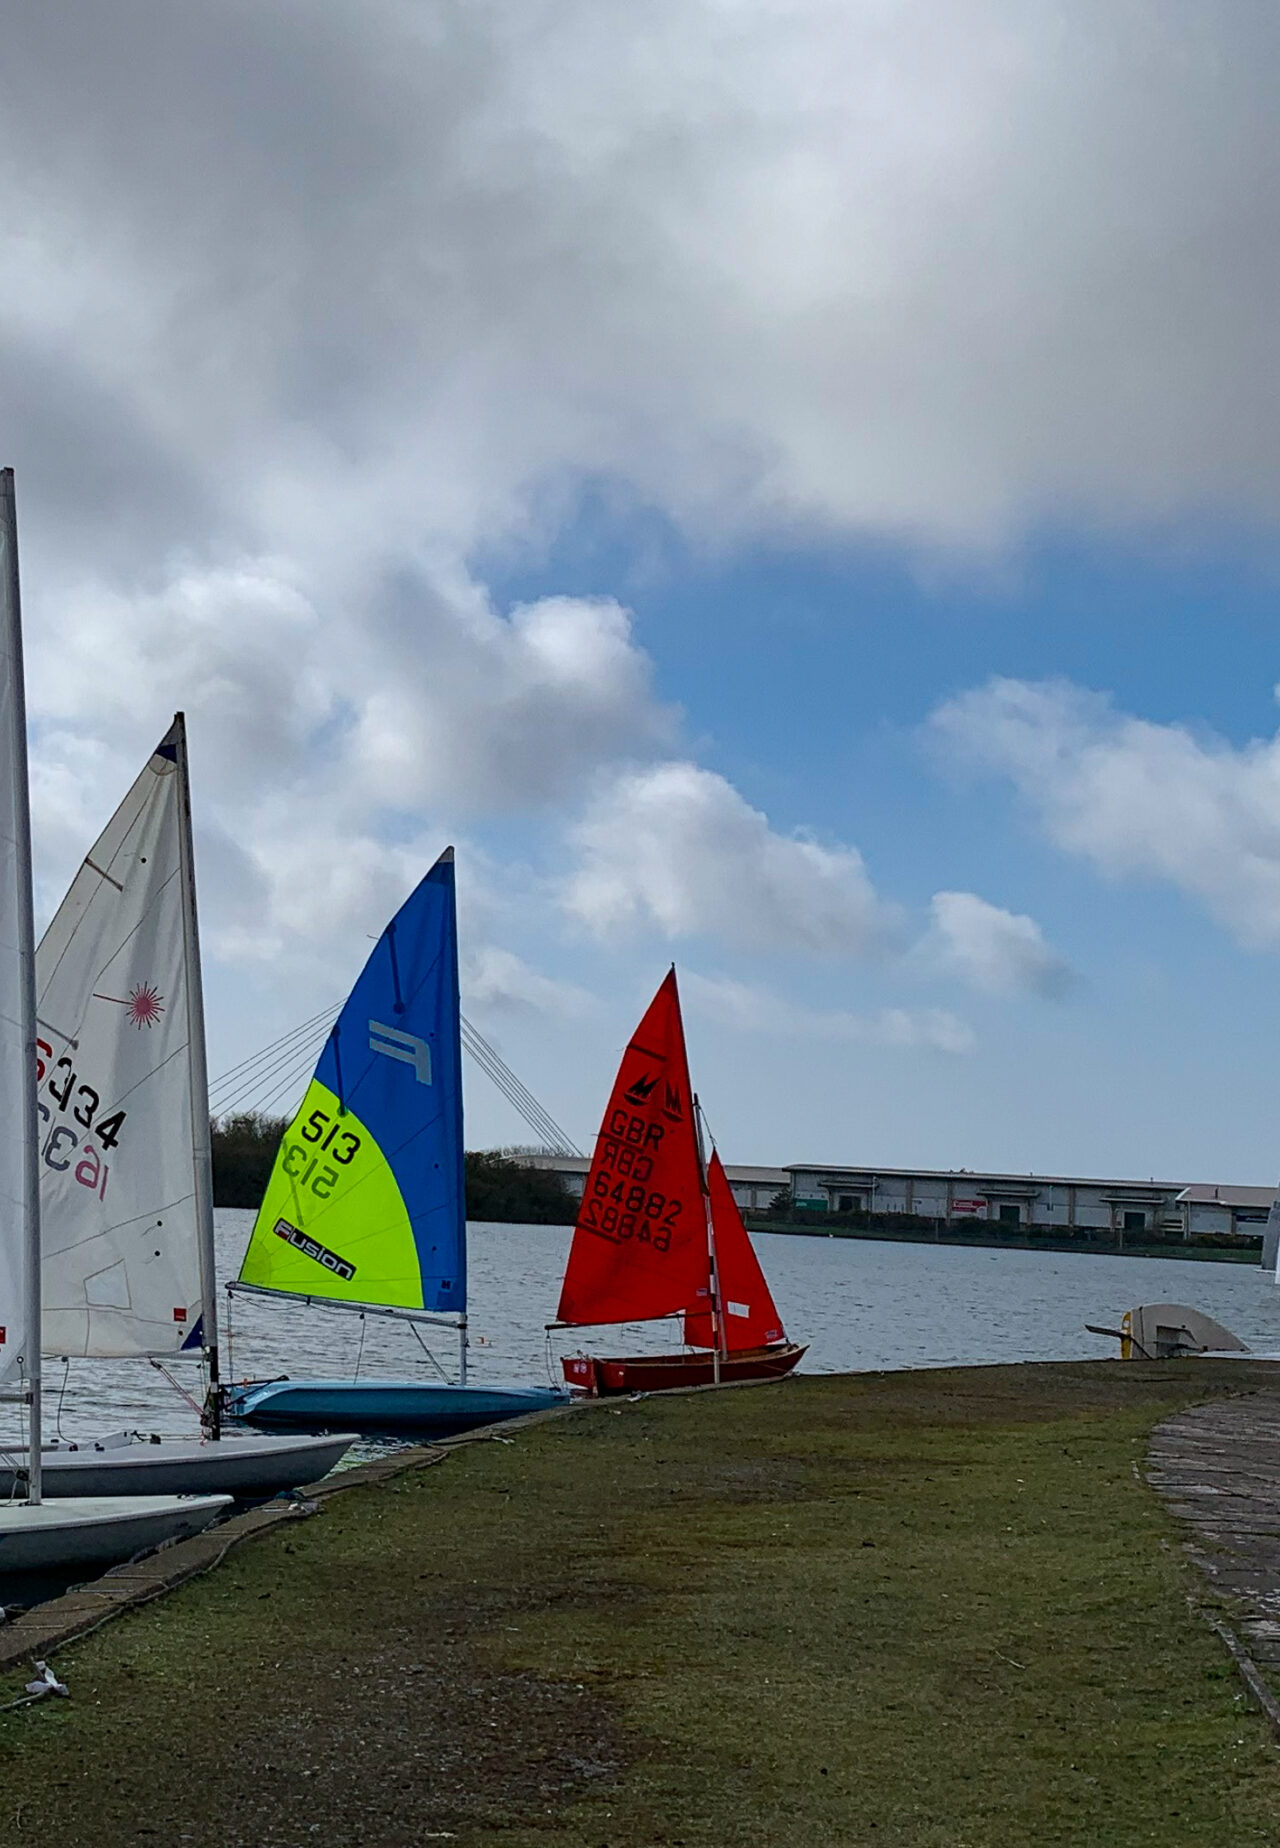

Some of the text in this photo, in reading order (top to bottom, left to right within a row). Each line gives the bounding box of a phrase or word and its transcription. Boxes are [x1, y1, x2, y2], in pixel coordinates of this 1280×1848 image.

[301, 1109, 361, 1165] 513
[610, 1109, 665, 1150] GBR
[593, 1170, 682, 1226] 64882
[275, 1220, 353, 1279] Fusion
